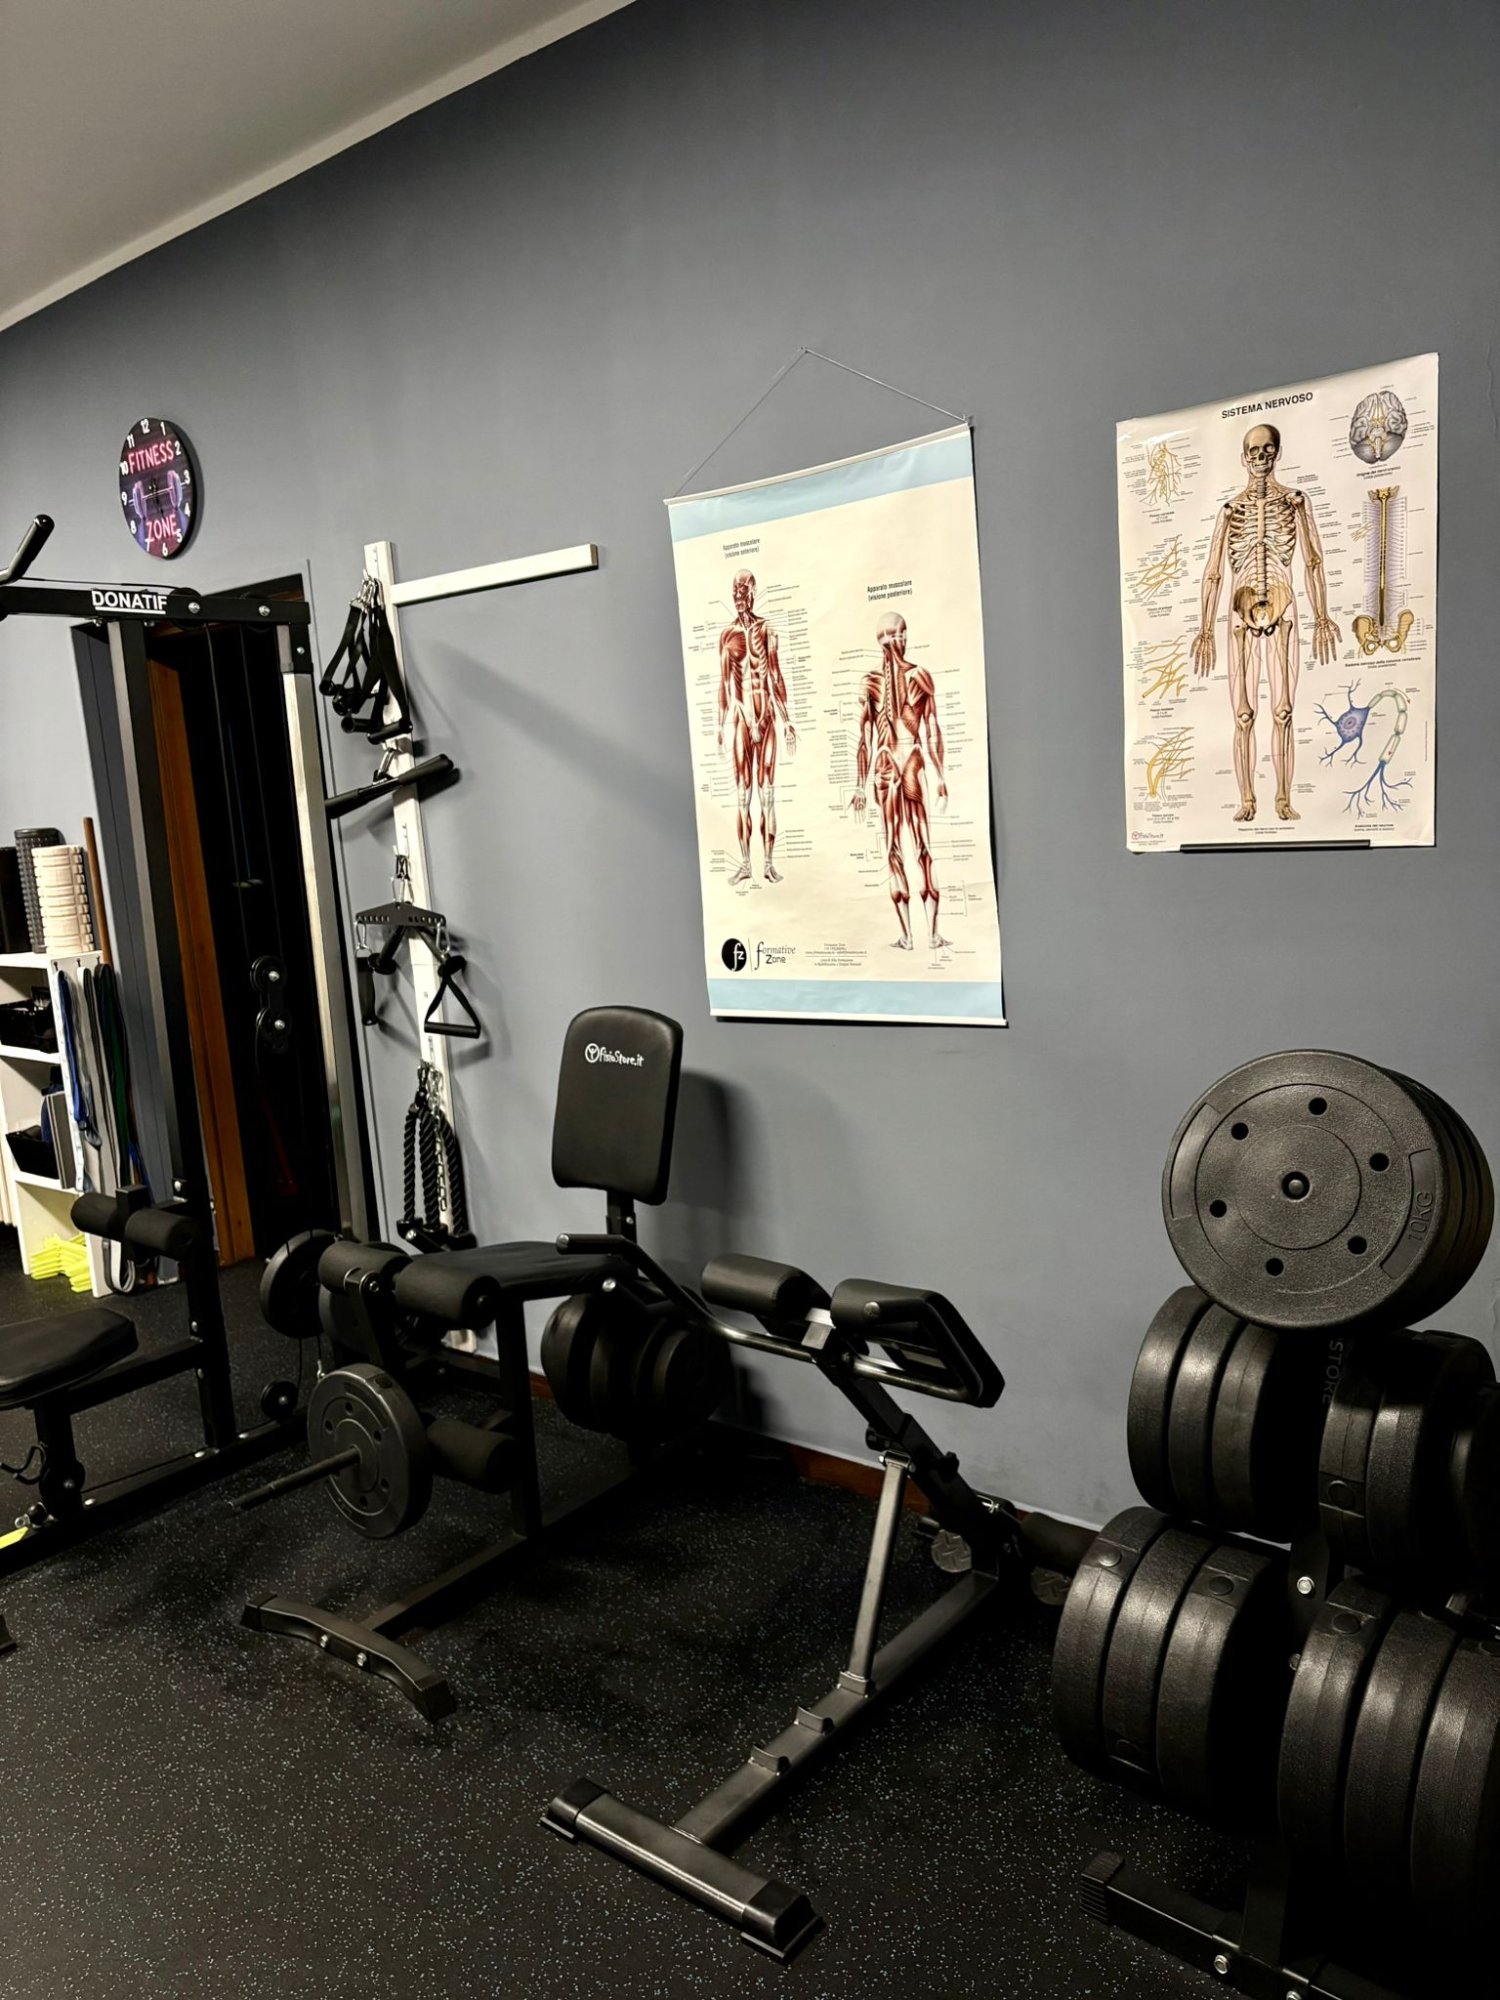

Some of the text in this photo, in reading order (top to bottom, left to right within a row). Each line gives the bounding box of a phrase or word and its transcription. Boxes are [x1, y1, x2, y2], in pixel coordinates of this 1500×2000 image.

[1221, 391, 1314, 419] SISTEMA NERVOSO
[140, 418, 150, 434] 12
[160, 421, 166, 436] 1
[126, 433, 135, 448] 11
[174, 440, 182, 456] 2
[128, 440, 174, 474] FITNESS
[120, 460, 129, 476] 10
[183, 469, 191, 484] 3
[121, 491, 128, 506] 9
[184, 502, 191, 517] 4
[129, 520, 137, 534] 8
[145, 514, 177, 542] ZONE
[175, 528, 182, 543] 5
[161, 542, 168, 557] 6
[91, 590, 168, 610] DONATIF
[765, 954, 786, 964] Zone
